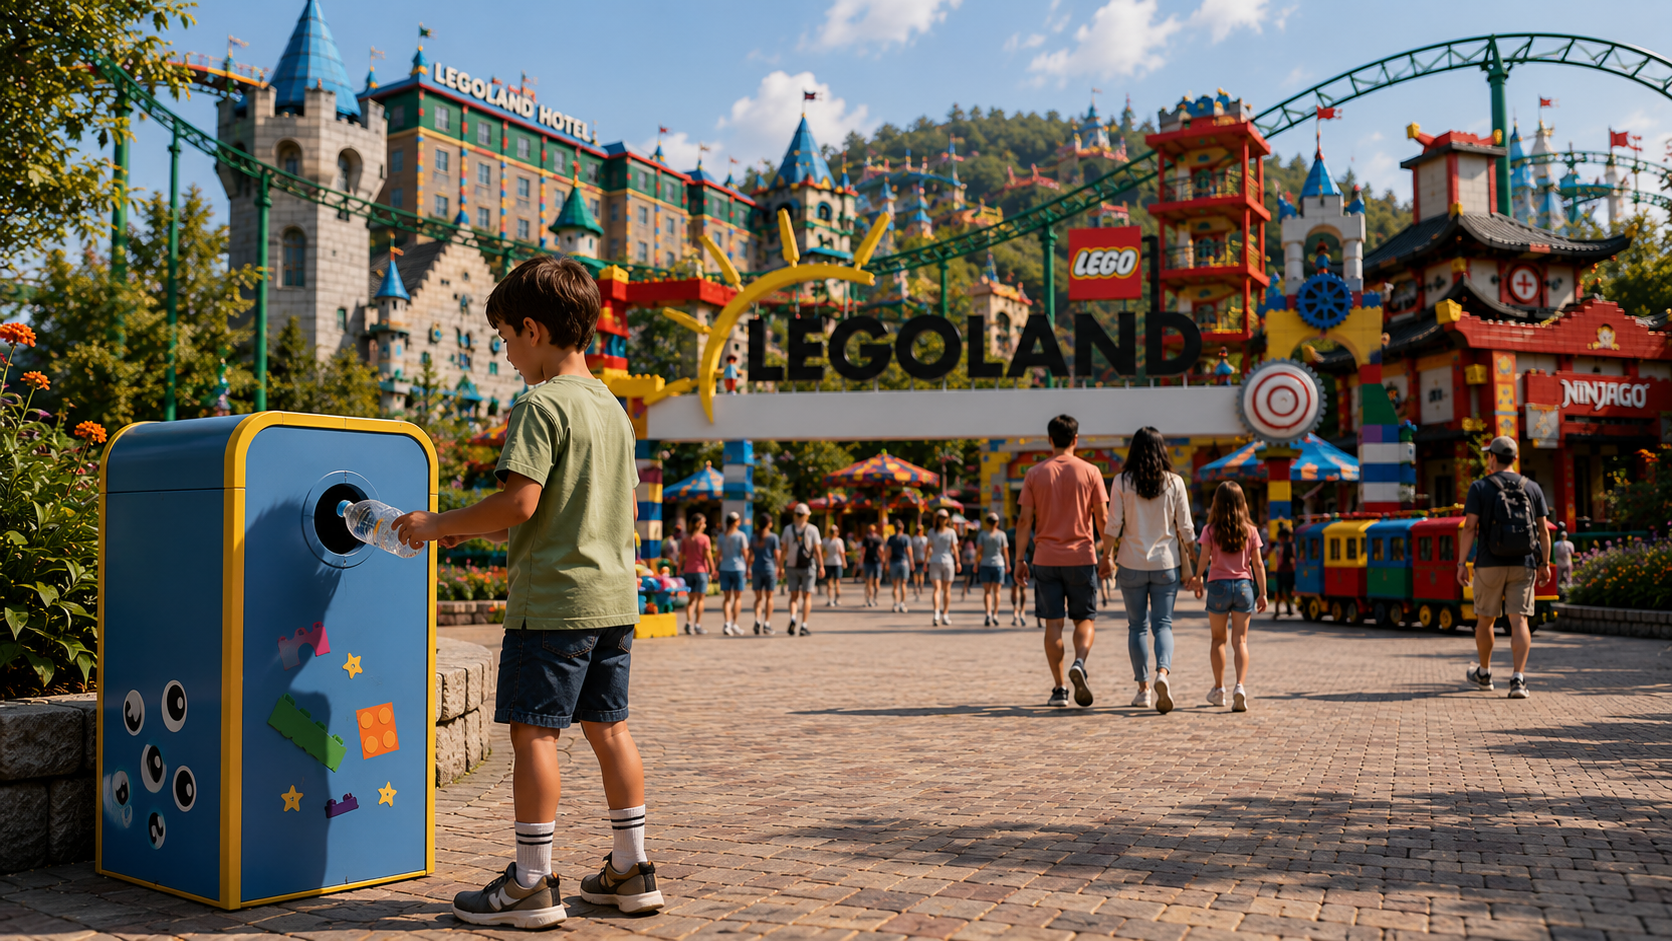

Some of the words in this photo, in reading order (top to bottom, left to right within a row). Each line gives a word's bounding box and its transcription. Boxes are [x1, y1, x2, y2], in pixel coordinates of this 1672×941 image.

[434, 62, 534, 118] LEGOLAND
[538, 104, 592, 142] HOTEL
[1074, 249, 1136, 276] LEGO
[748, 311, 1200, 382] LEGOLAND
[1560, 379, 1650, 411] NINJAGO
